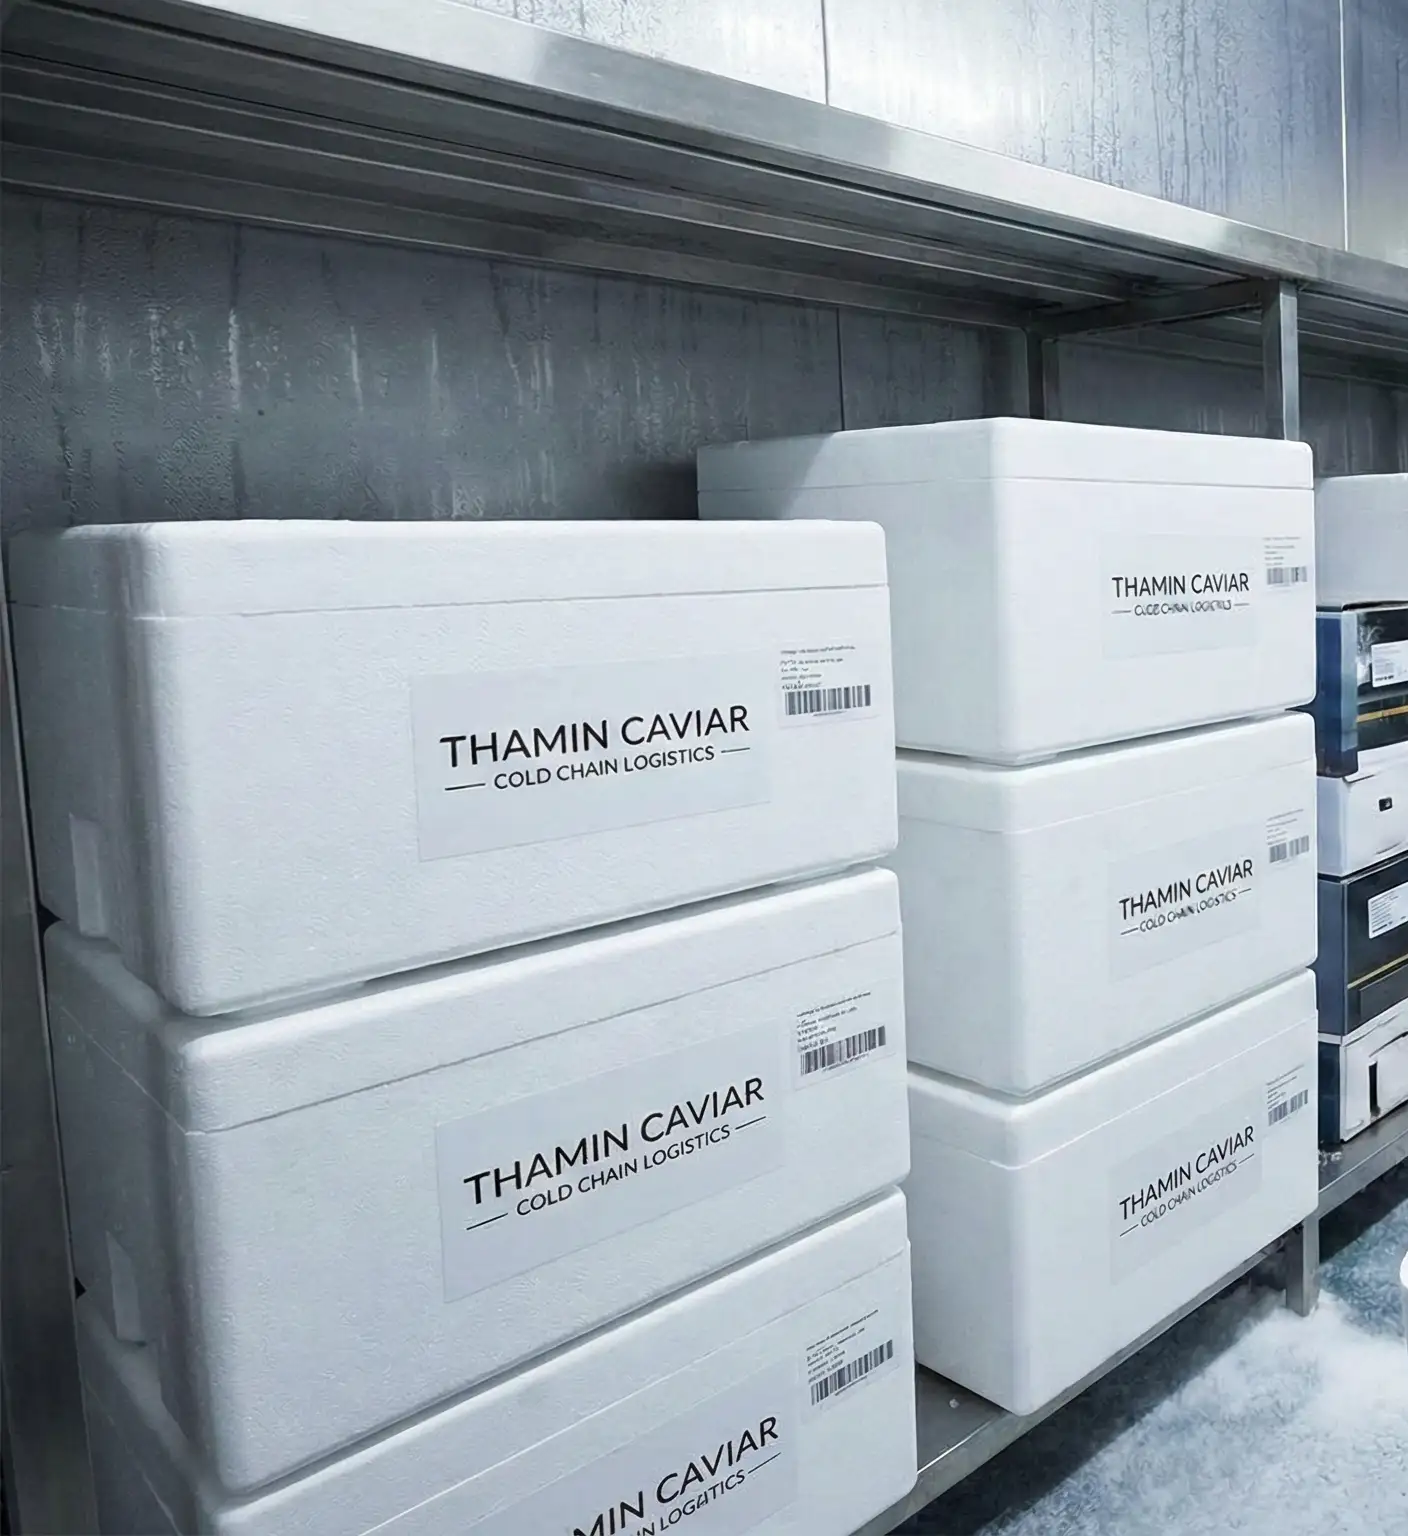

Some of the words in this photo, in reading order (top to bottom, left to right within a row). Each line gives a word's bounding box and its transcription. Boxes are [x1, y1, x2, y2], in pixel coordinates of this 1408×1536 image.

[1111, 575, 1186, 598] THAMIN
[1191, 572, 1250, 595] CAVIAR
[439, 719, 609, 768] THAMIN
[620, 704, 750, 746] CAVIAR
[493, 767, 551, 790] COLD
[556, 758, 618, 782] CHAIN
[623, 745, 715, 773] LOGISTICS
[1118, 878, 1191, 920] THAMIN
[1195, 858, 1253, 894] CAVIAR
[463, 1123, 629, 1205] THAMIN
[640, 1076, 765, 1143] CAVIAR
[516, 1183, 573, 1217] COLD
[577, 1158, 638, 1193] CHAIN
[643, 1124, 731, 1170] LOGISTICS
[1118, 1161, 1191, 1220] THAMIN
[1195, 1125, 1254, 1174] CAVIAR
[656, 1415, 779, 1505] CAVIAR
